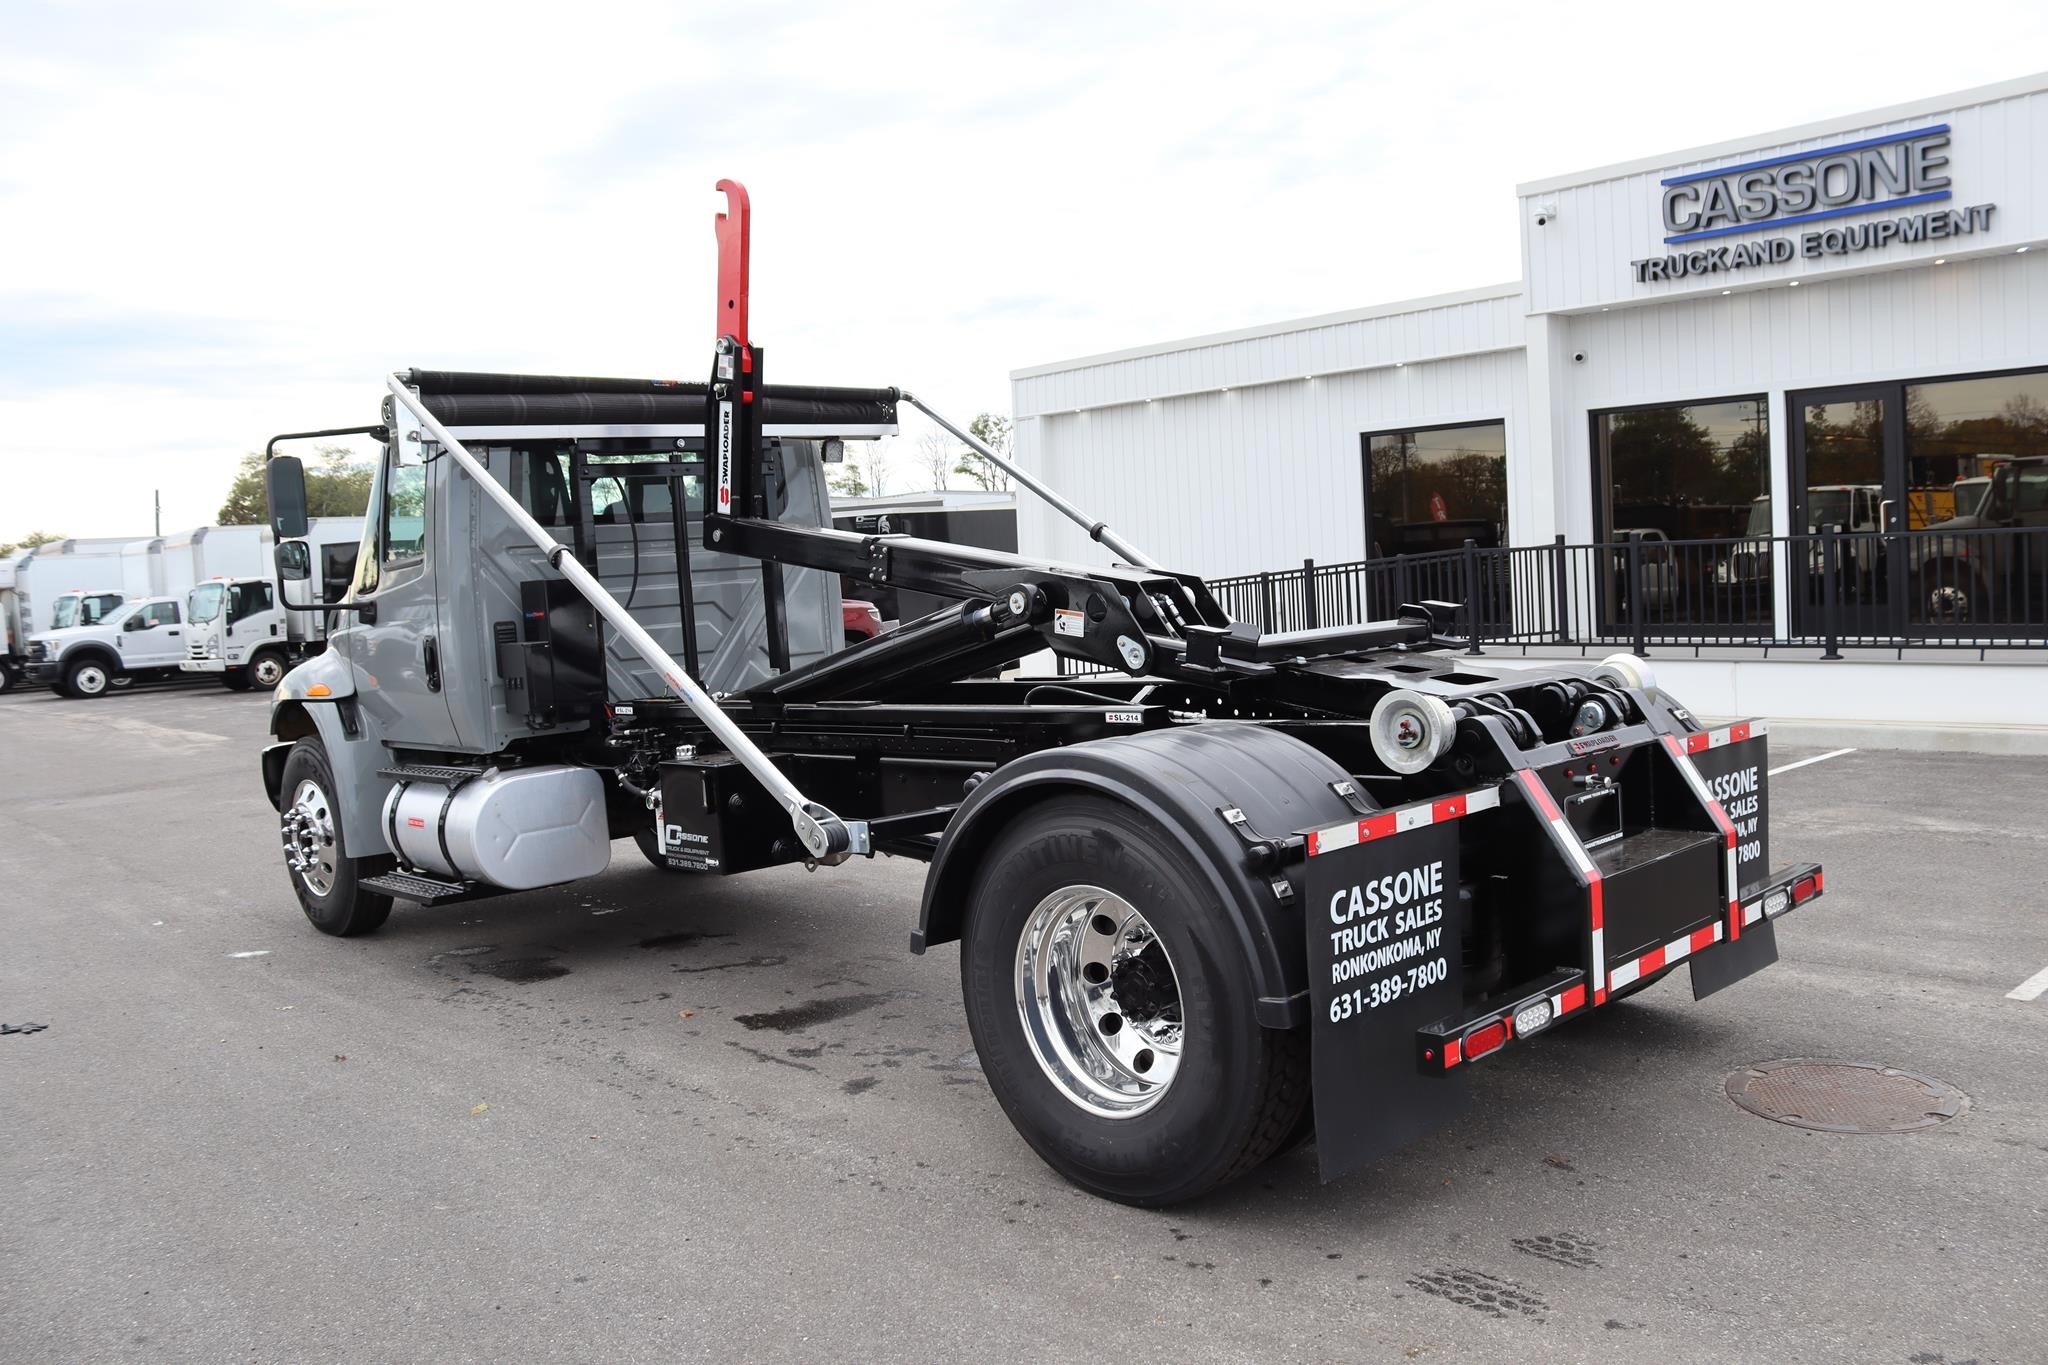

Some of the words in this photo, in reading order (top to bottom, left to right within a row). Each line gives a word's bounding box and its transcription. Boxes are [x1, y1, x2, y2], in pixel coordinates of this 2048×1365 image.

[1662, 136, 1951, 233] CASSONE
[1630, 246, 1729, 283] TRUCK
[1729, 237, 1795, 270] AND
[1801, 203, 1996, 259] EQUIPMENT
[721, 410, 731, 485] SWAPLOADER
[1114, 714, 1139, 722] SL-214
[1707, 766, 1759, 802] ASSONE
[1730, 795, 1759, 820] SALES
[684, 847, 710, 856] EQUIPMENT
[1330, 860, 1443, 925] CASSONE
[1331, 916, 1389, 956] TRUCK
[1395, 899, 1443, 935] SALES
[1332, 935, 1425, 985] RONKONKOMA,
[1426, 927, 1443, 951] NY
[1330, 957, 1447, 1023] 631-389-7800
